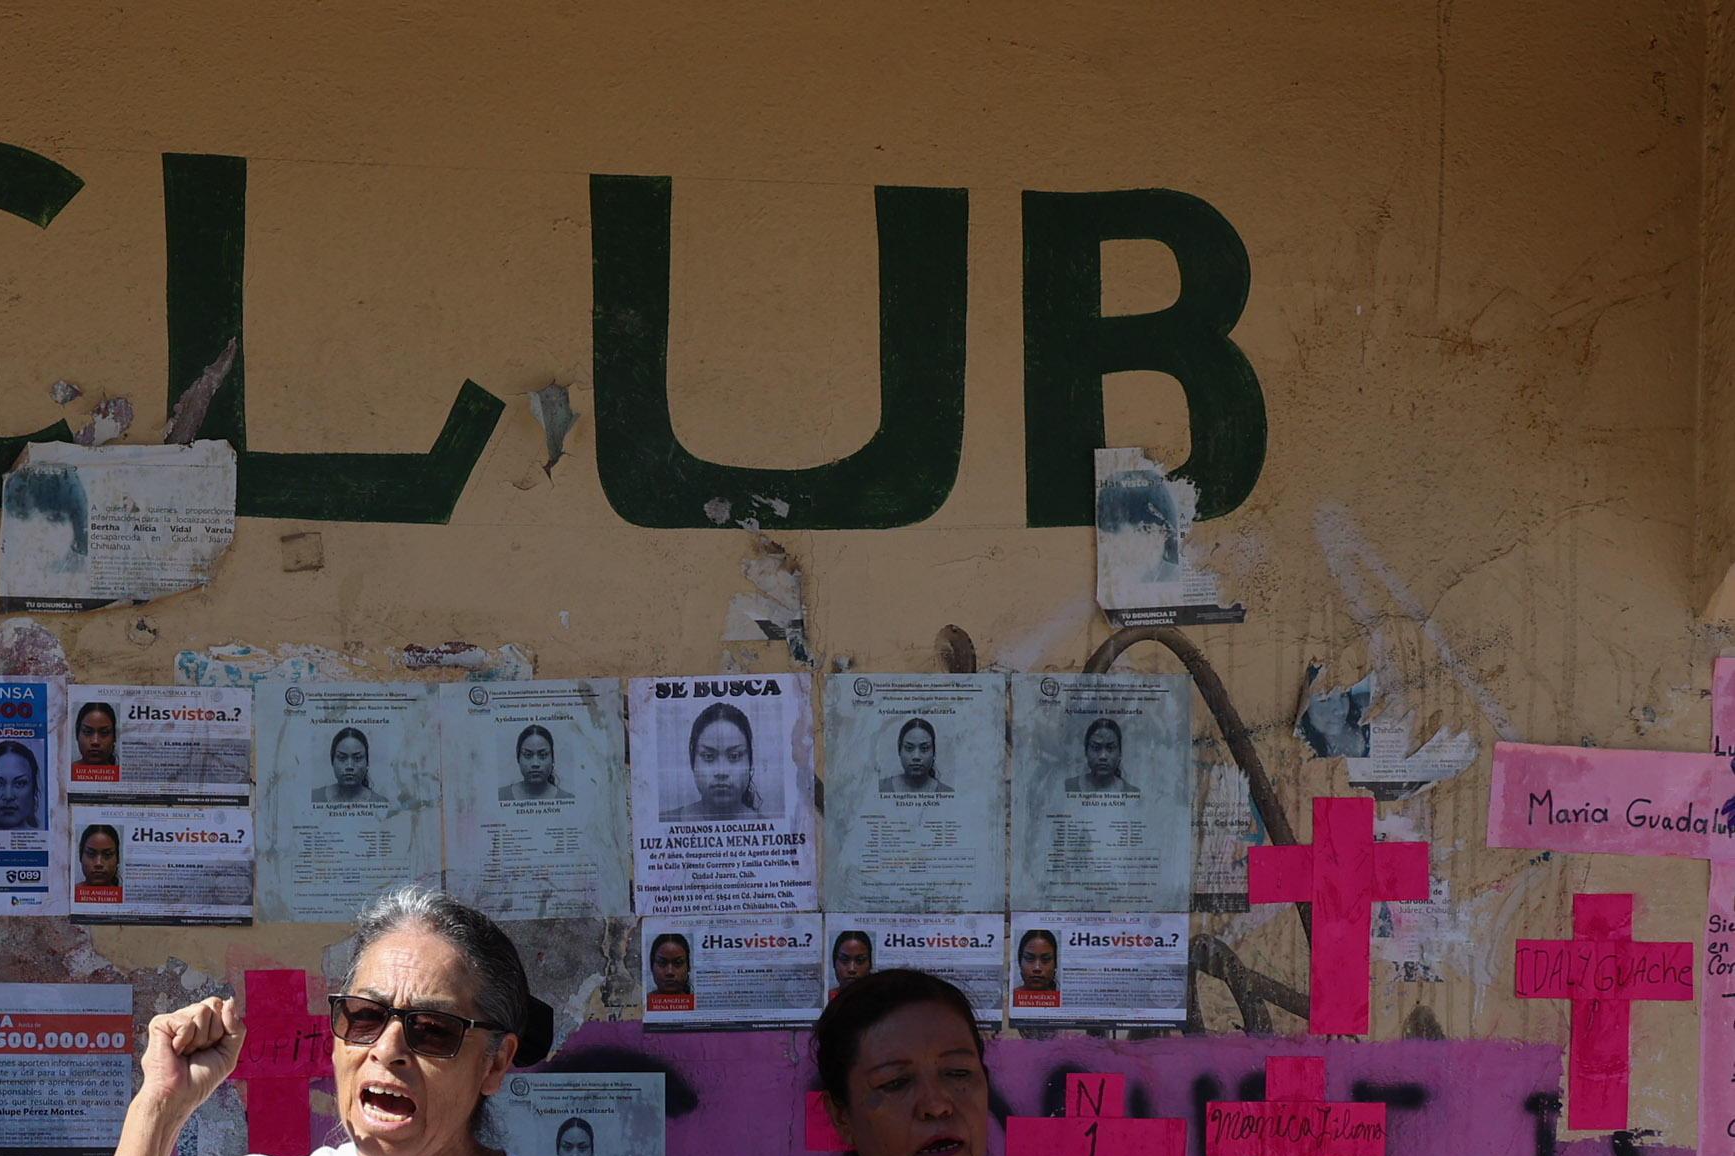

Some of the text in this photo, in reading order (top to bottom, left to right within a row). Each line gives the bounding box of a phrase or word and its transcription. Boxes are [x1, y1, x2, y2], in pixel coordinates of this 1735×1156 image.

[106, 505, 127, 513] quien
[148, 506, 177, 515] quienes
[91, 513, 138, 522] información
[91, 523, 120, 531] Bertha
[133, 524, 157, 532] Alicia
[170, 525, 191, 533] Vidal
[91, 533, 141, 541] desaparecida
[172, 535, 197, 543] Ciudad
[1133, 611, 1163, 619] DENUNCIA
[1125, 618, 1174, 626] CONFIDENCIAL
[655, 679, 782, 699] SE BUSCA
[4, 728, 35, 738] Flores
[669, 823, 774, 835] AYUDANOS A LOCALIZAR A
[640, 833, 806, 850] LUZ ANGÉLICA MENA FLORES
[19, 872, 39, 881] 089
[18, 1060, 50, 1069] aporten
[51, 1058, 99, 1067] información
[23, 1107, 48, 1116] Pérez
[50, 1108, 86, 1116] Montes.
